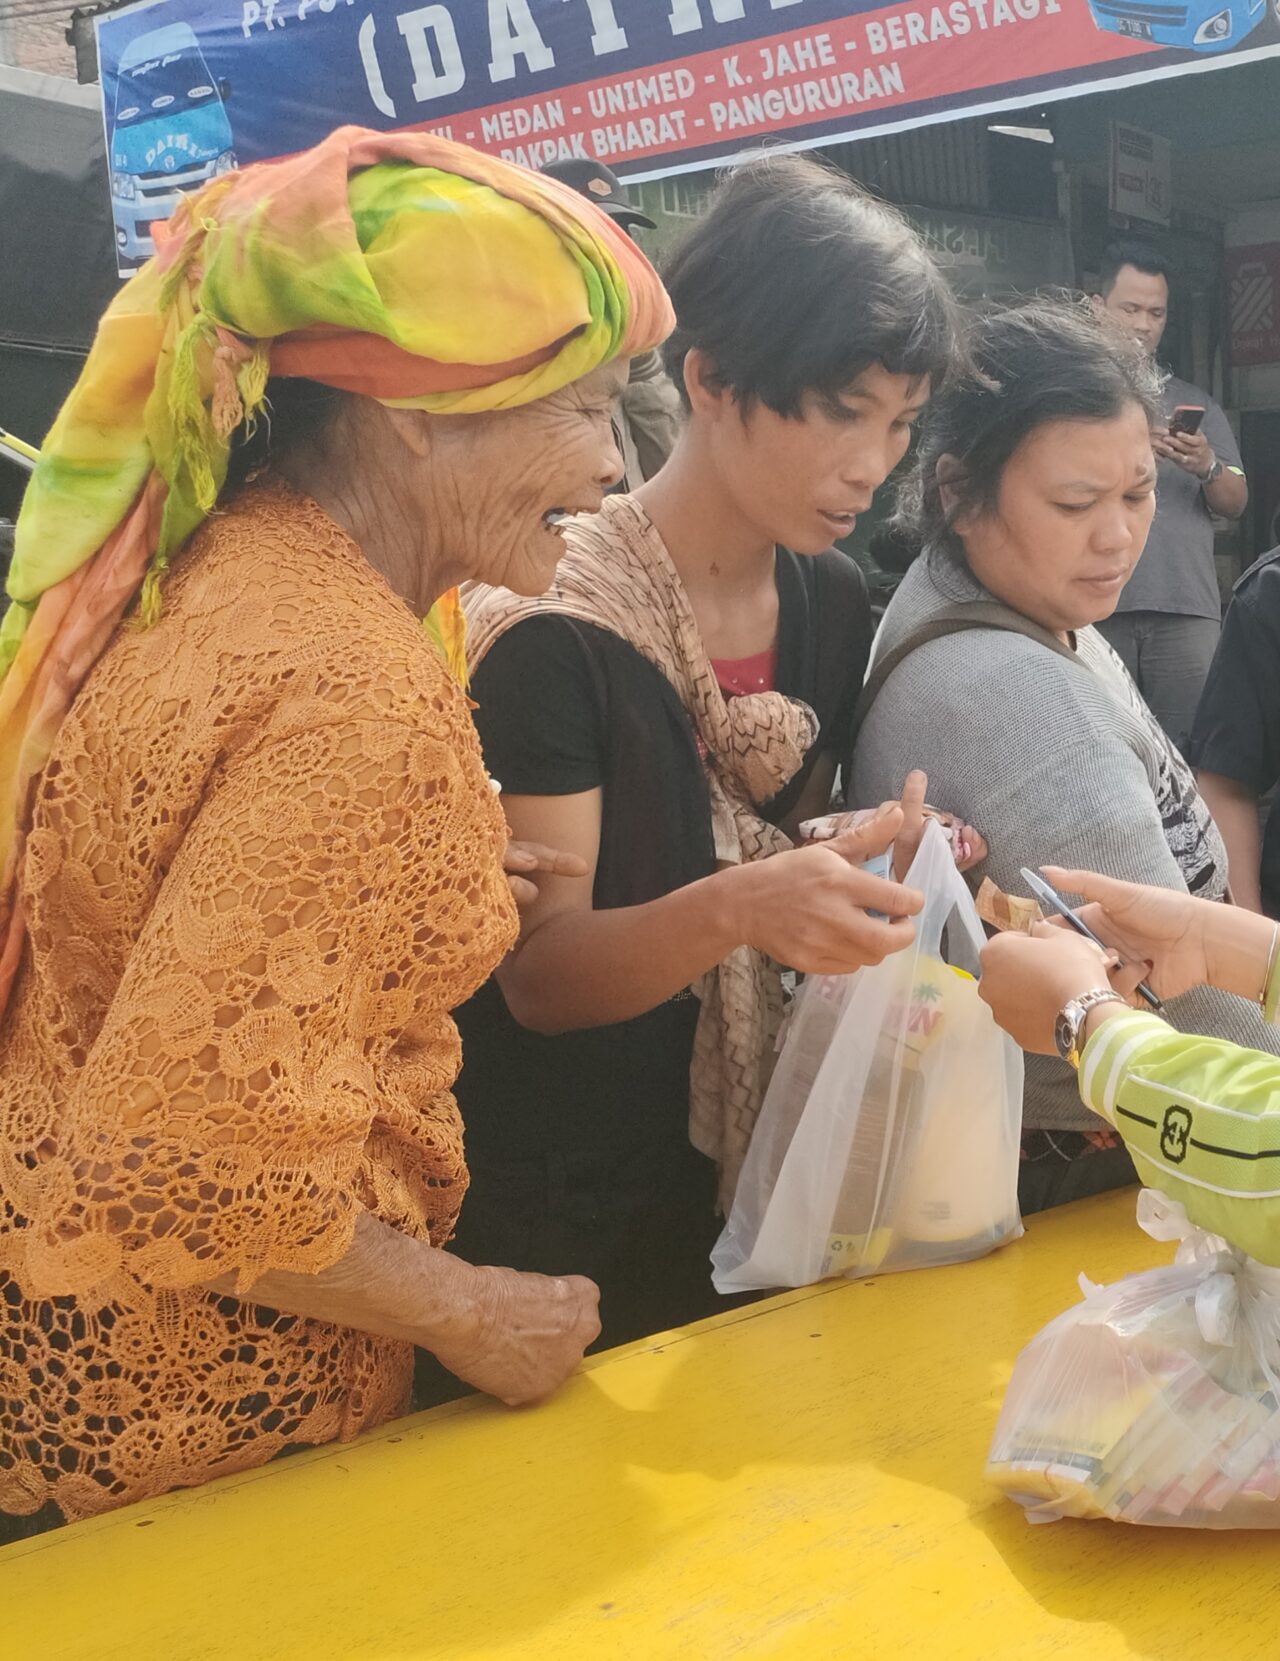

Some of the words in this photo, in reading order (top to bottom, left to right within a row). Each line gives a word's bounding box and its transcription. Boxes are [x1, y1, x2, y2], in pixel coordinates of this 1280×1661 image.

[480, 98, 565, 144] MEDAN
[588, 68, 696, 119] UNIMED
[722, 56, 753, 88] K.
[760, 33, 836, 80] JAHE
[591, 110, 686, 158] BHARAT
[709, 62, 905, 133] PANGURURAN
